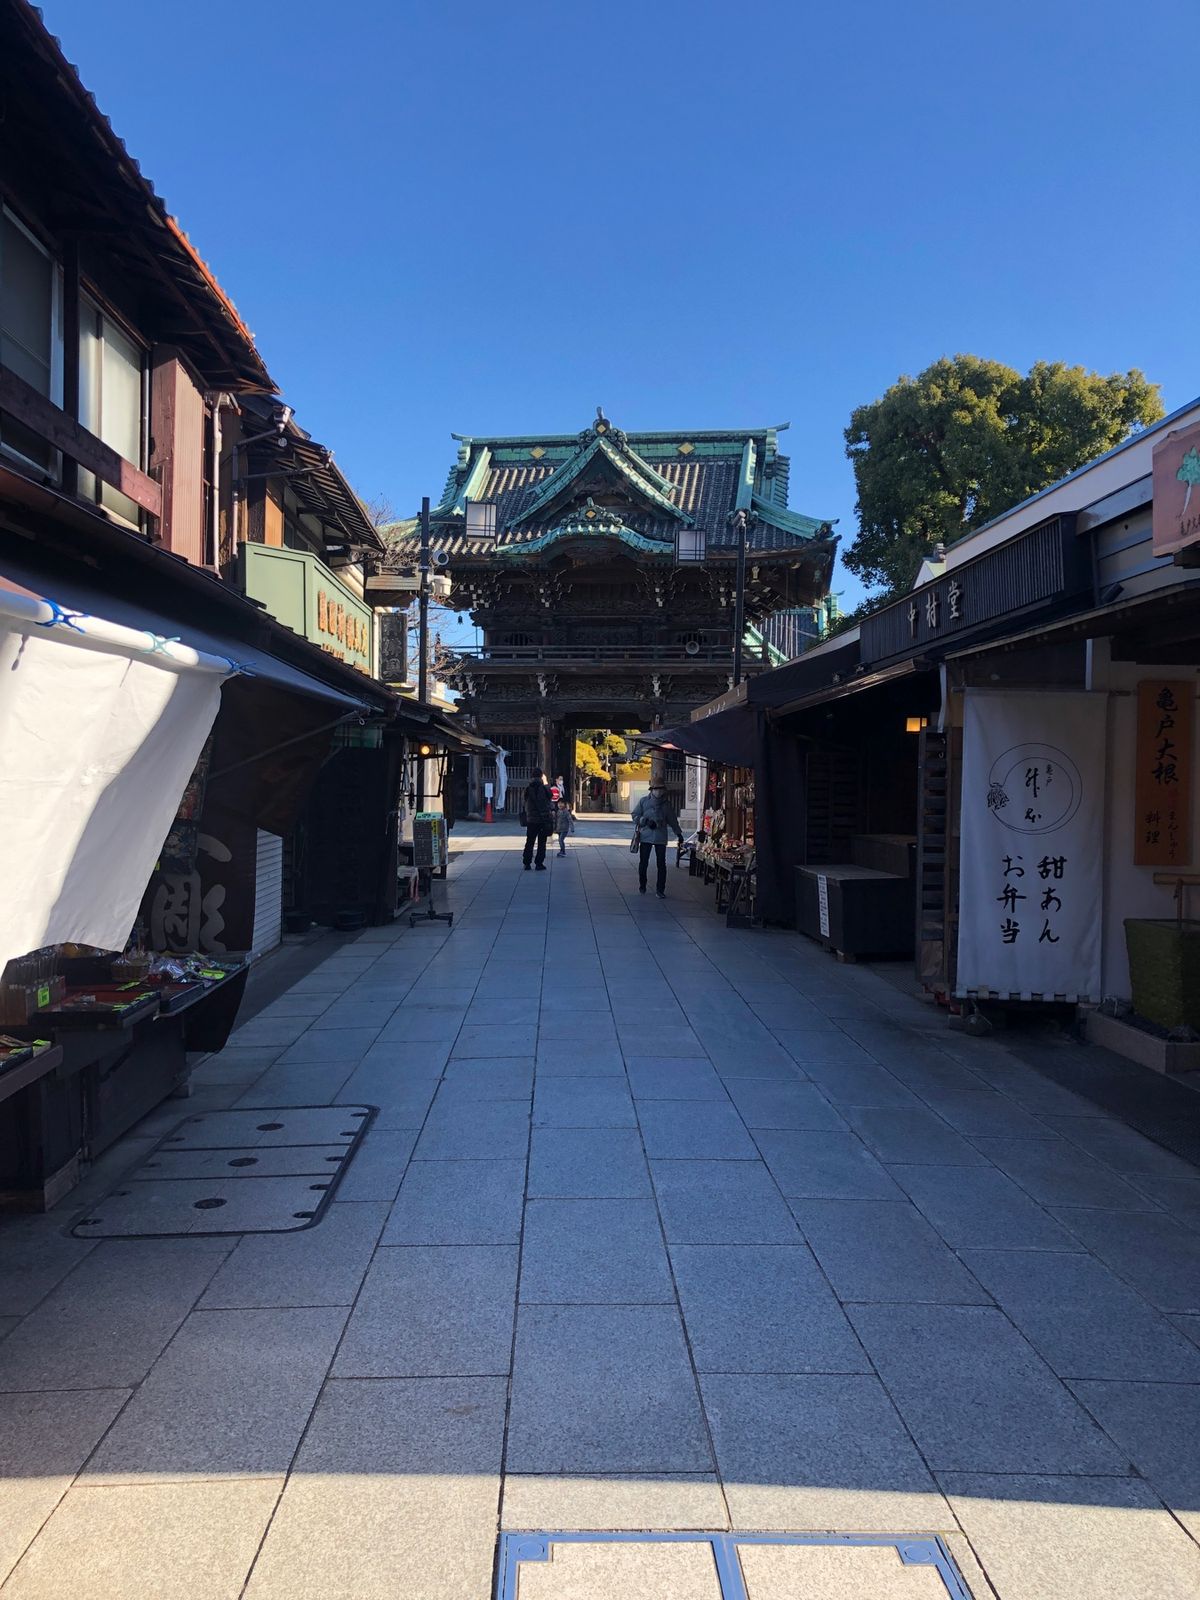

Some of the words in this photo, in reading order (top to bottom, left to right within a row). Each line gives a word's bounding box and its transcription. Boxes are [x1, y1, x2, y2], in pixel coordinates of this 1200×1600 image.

[907, 580, 961, 639] 中村堂
[1152, 686, 1179, 785] 亀戸大根
[1144, 810, 1161, 845] 料理
[997, 855, 1027, 944] お弁当
[1037, 855, 1068, 943] 甜あん
